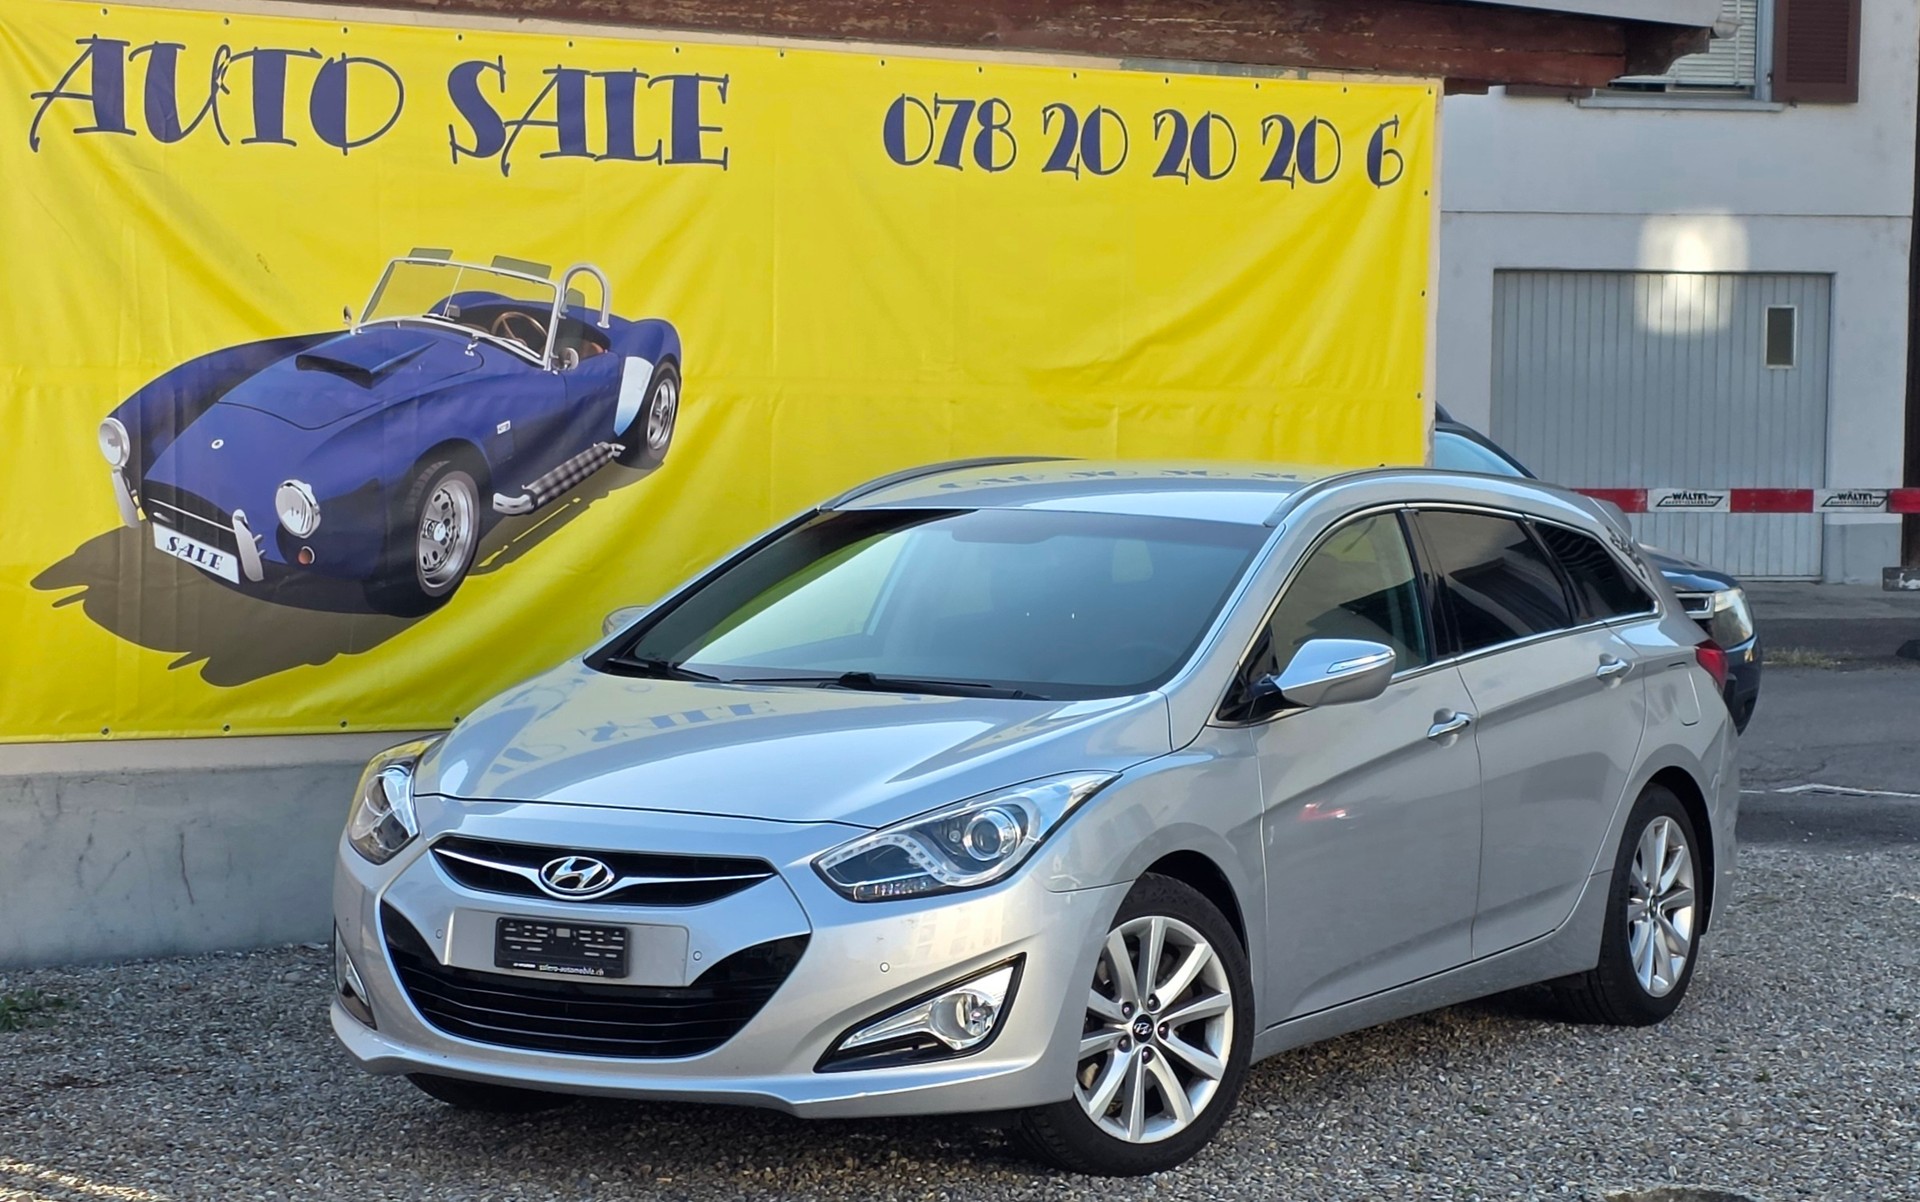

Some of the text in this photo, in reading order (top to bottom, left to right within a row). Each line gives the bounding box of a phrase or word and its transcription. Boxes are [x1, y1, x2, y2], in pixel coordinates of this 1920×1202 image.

[29, 35, 729, 178] AUTO SALE
[883, 92, 1404, 189] 078 20 20 20 6
[166, 536, 223, 571] SALE
